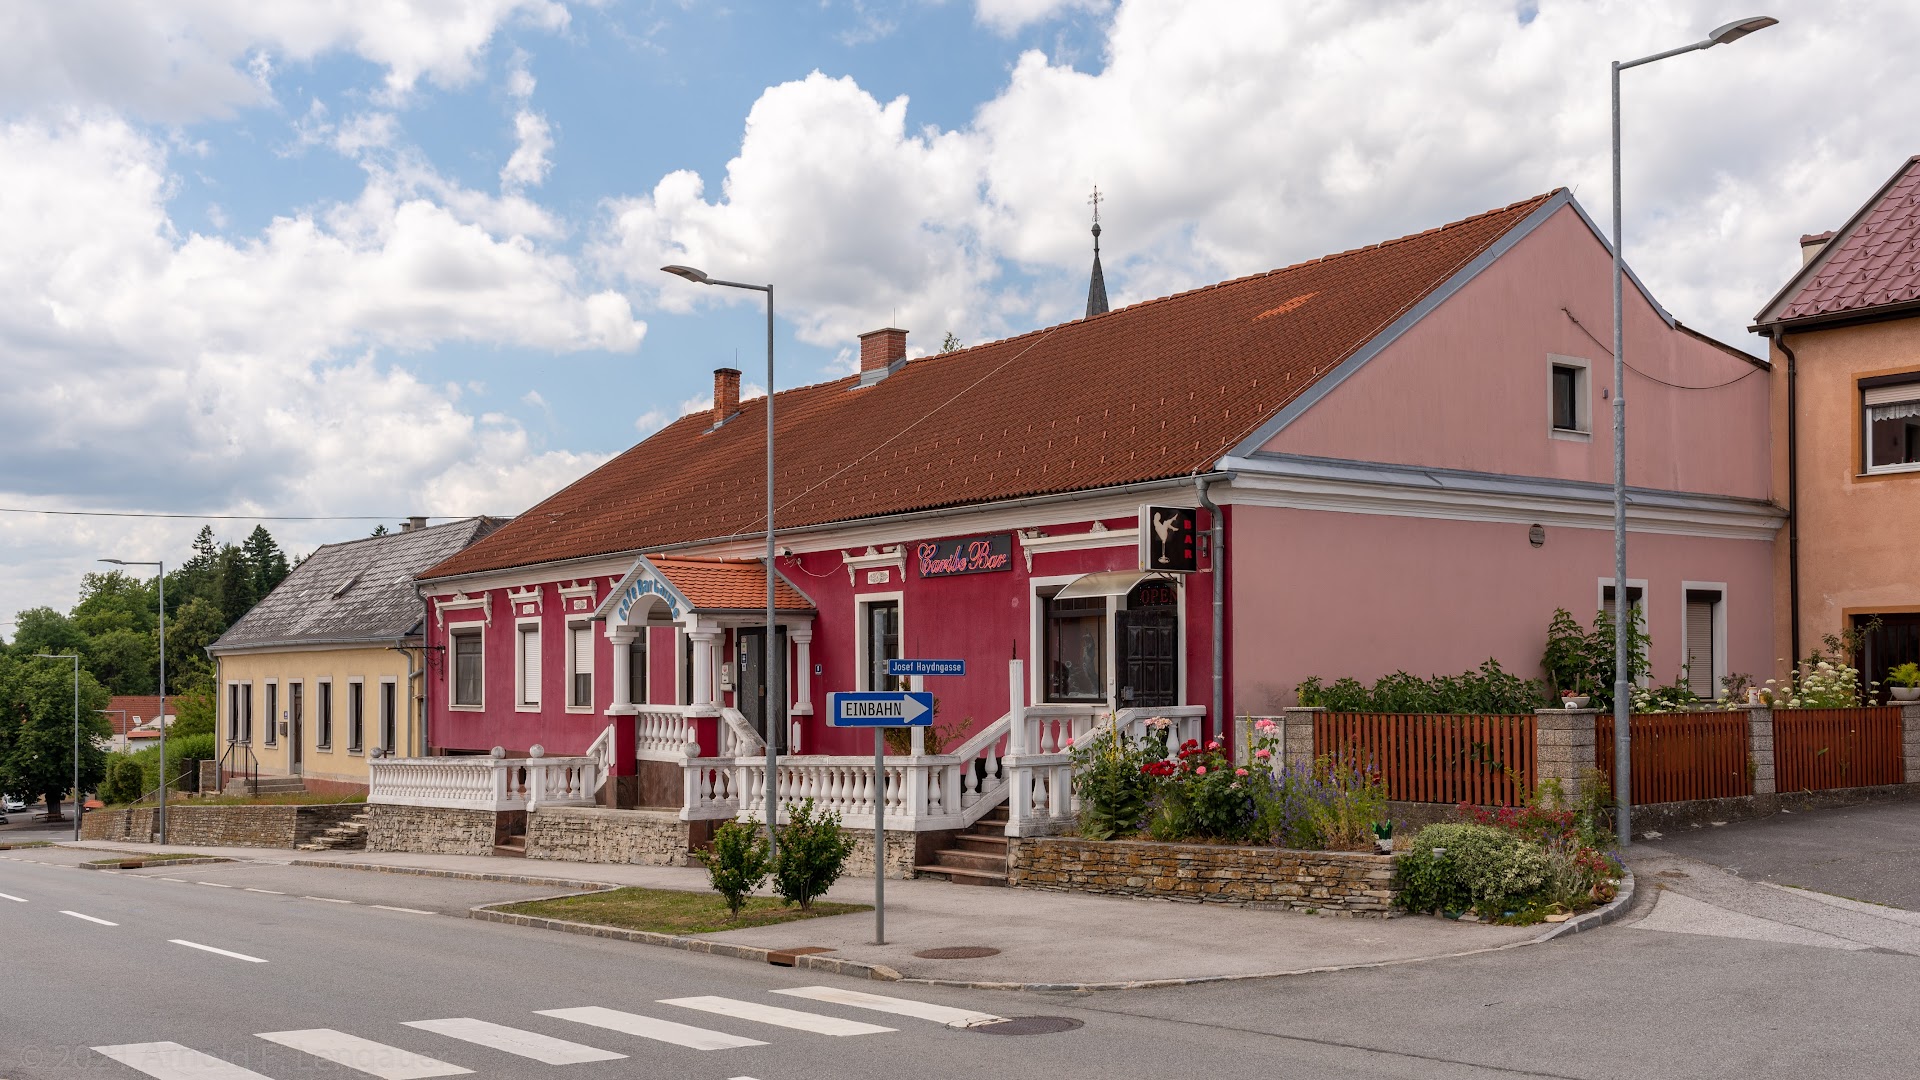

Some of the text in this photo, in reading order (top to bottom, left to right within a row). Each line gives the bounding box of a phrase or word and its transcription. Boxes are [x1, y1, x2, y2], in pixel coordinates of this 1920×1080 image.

[1184, 519, 1192, 559] BAR
[917, 541, 1007, 576] Caribe Bar
[637, 579, 653, 596] Bar
[892, 661, 961, 673] Josef Haydngasse
[846, 702, 902, 716] EINBAHN
